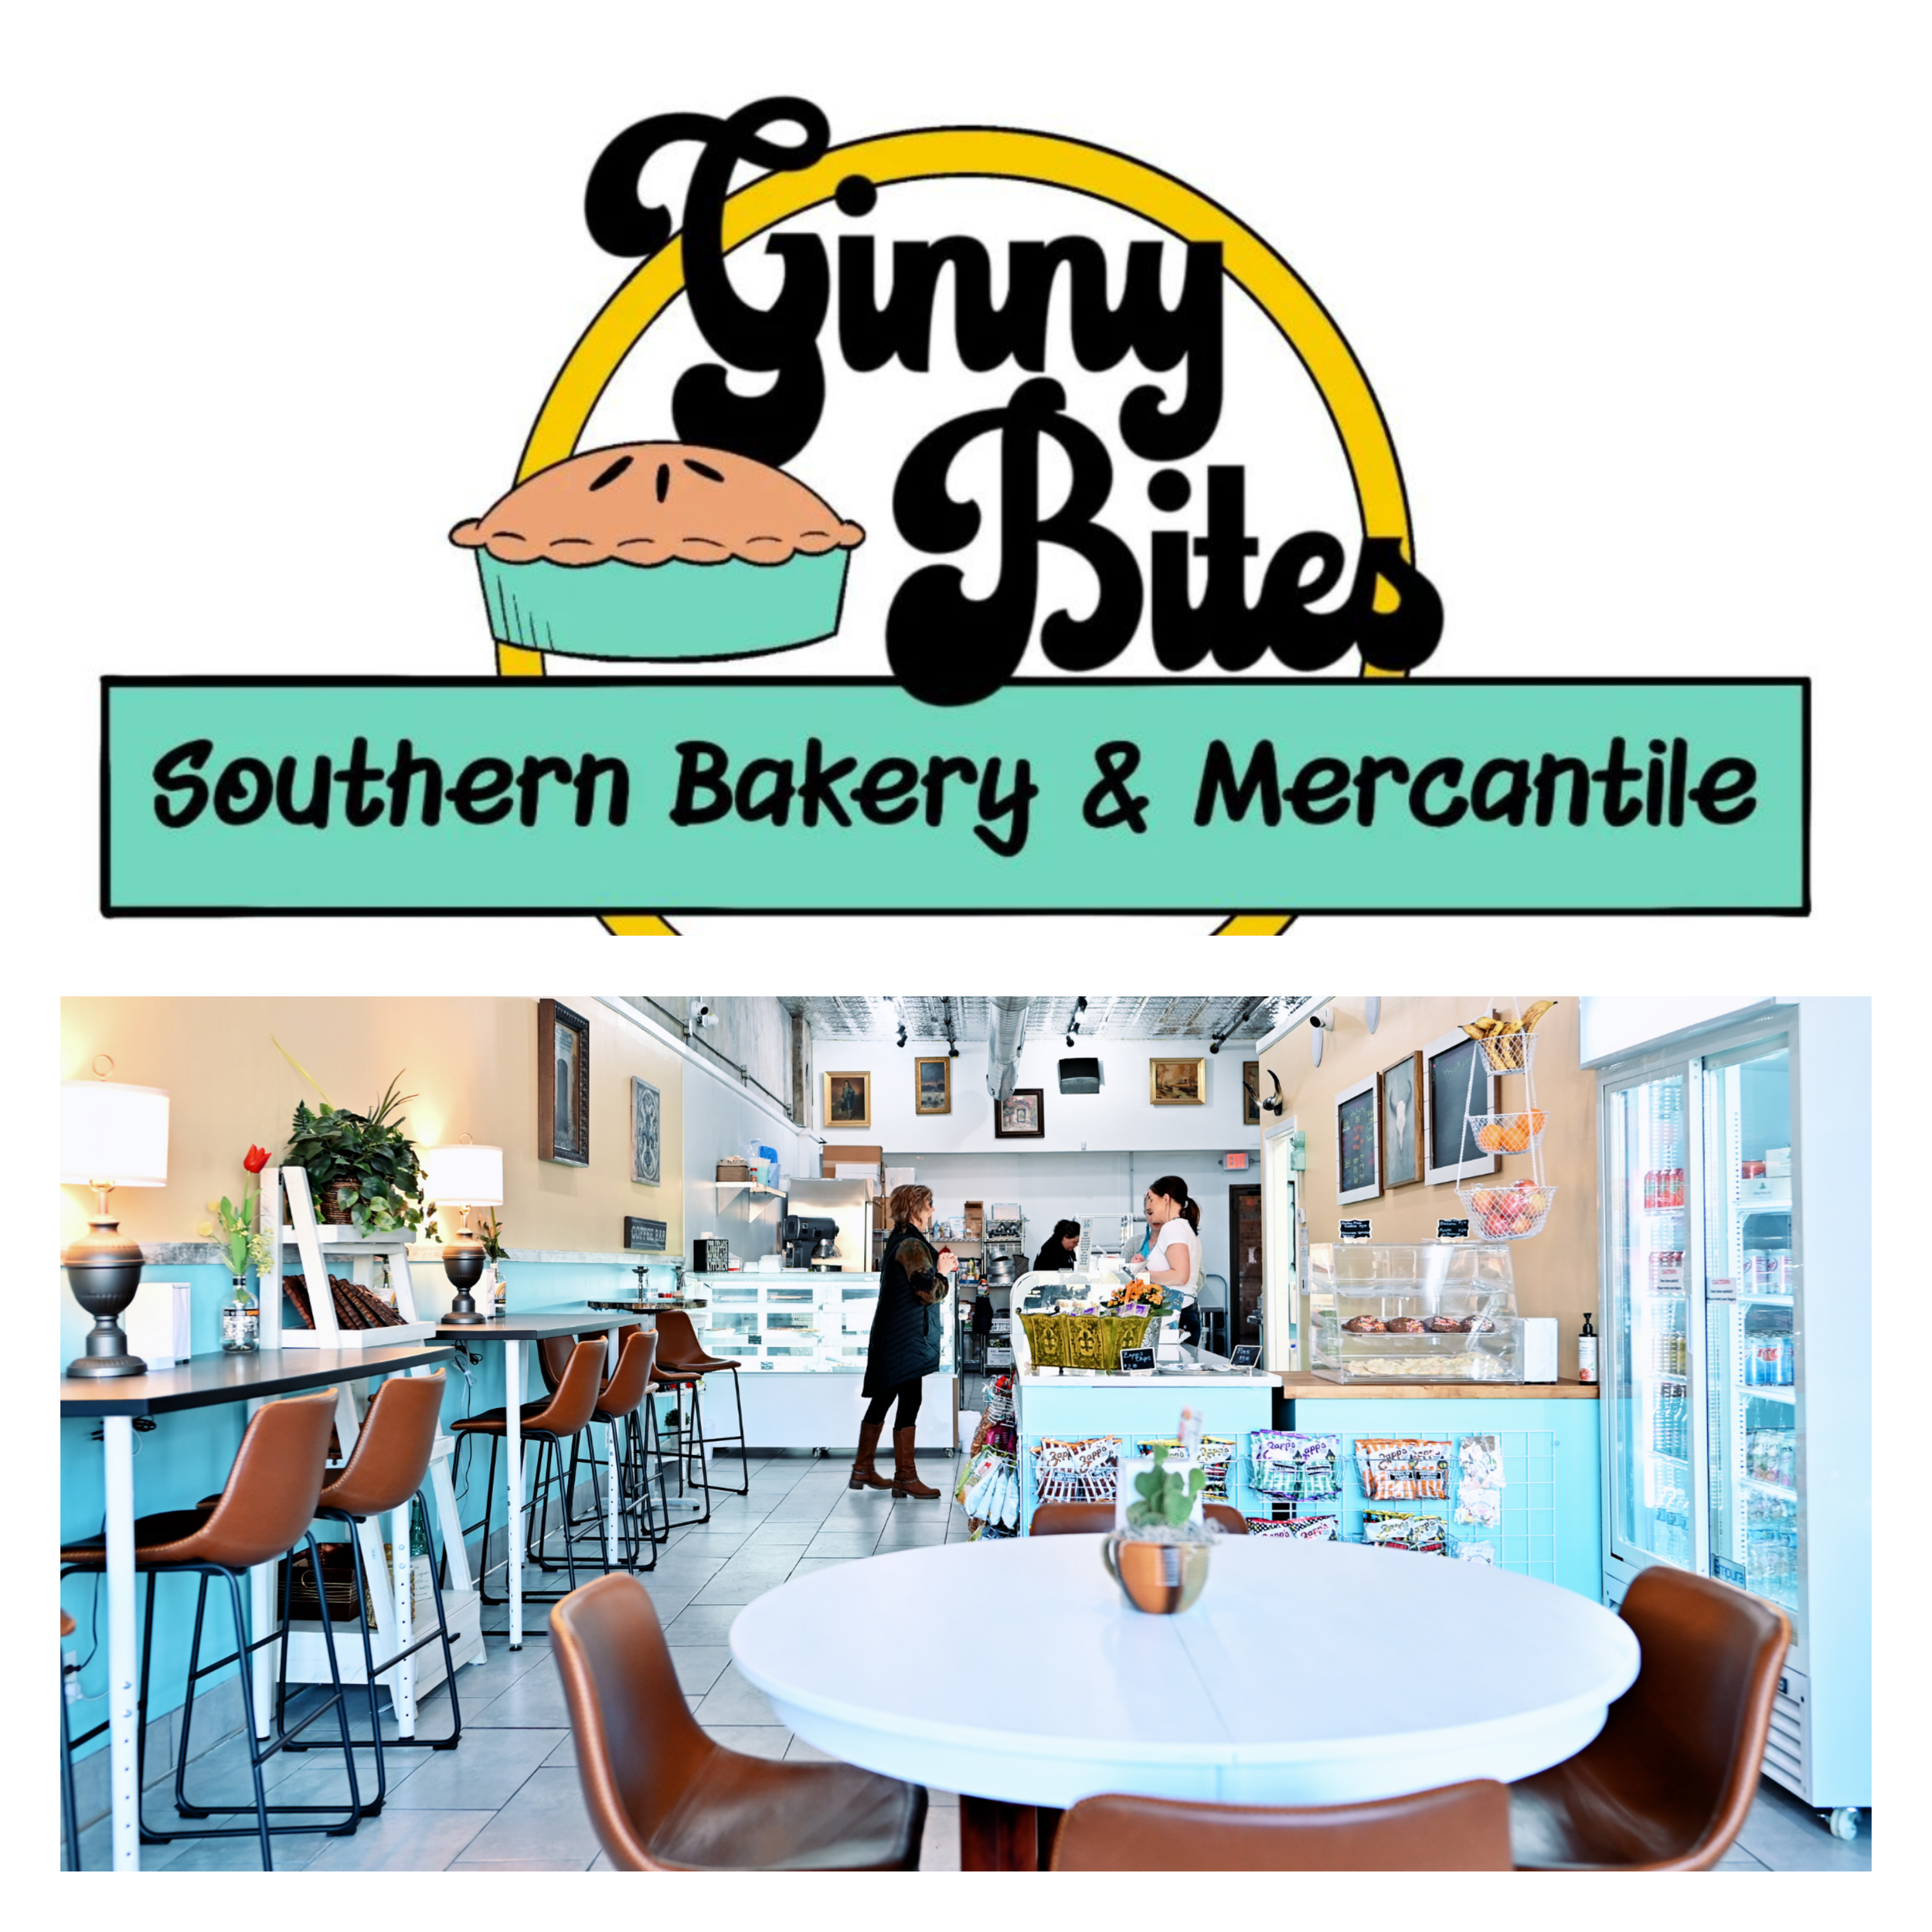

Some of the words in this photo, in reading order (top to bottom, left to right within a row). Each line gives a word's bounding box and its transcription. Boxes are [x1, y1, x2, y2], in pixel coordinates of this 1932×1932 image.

[1227, 1153, 1246, 1168] EXIT
[631, 1226, 654, 1240] COFFEE
[655, 1229, 666, 1242] BAR
